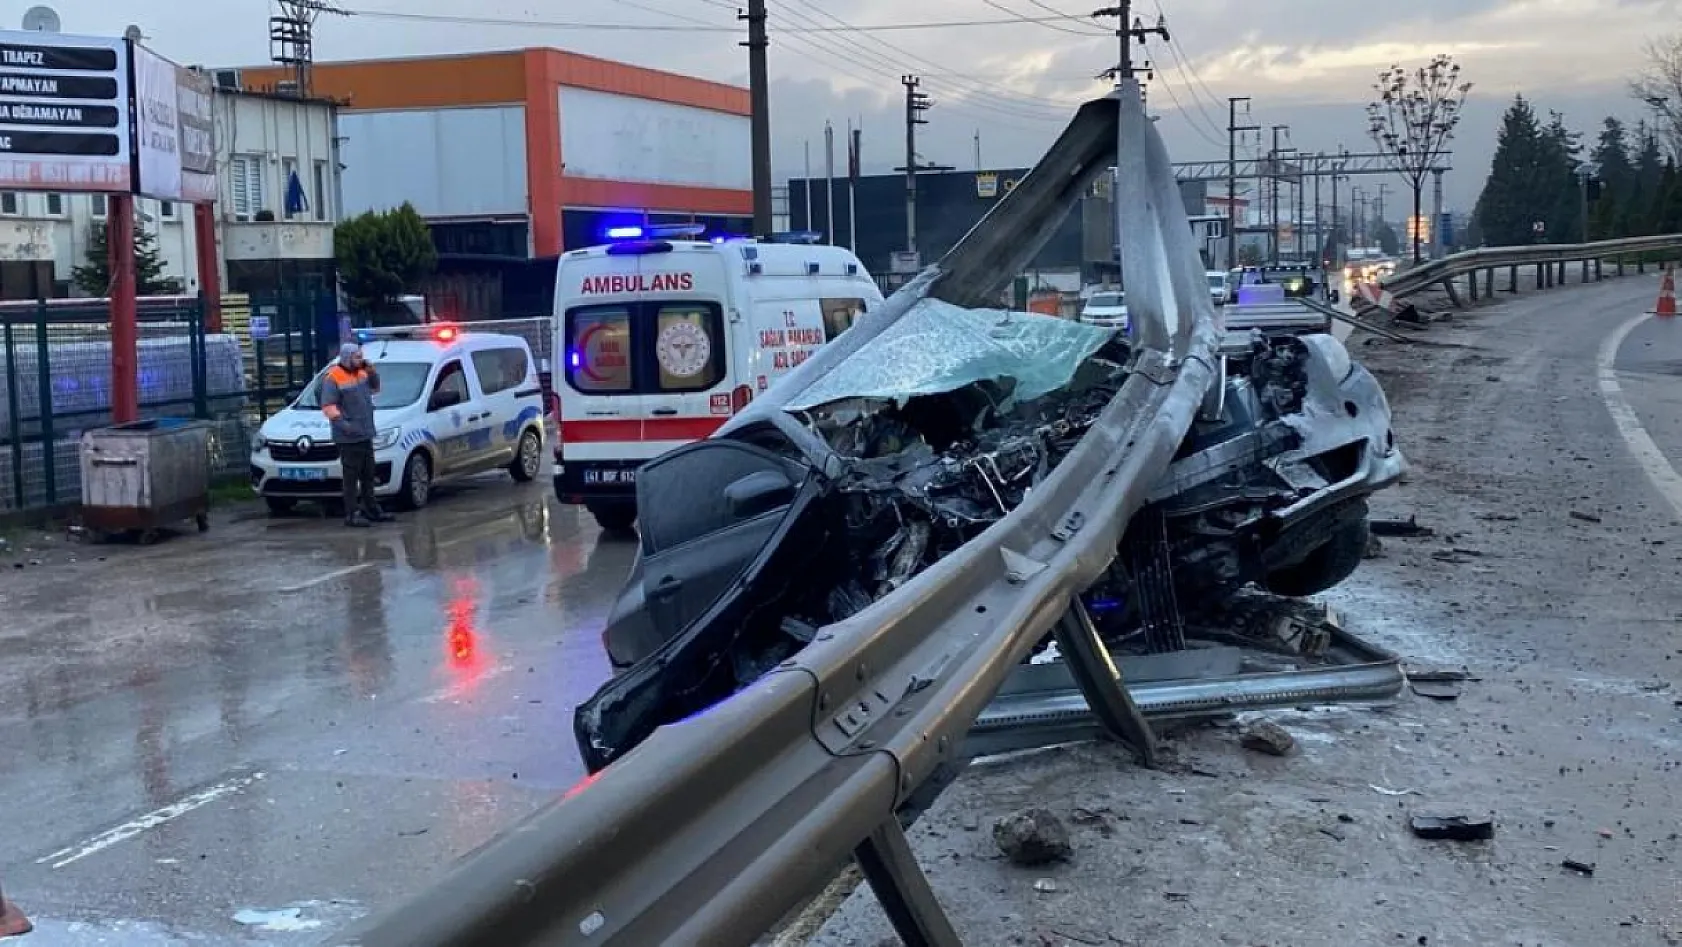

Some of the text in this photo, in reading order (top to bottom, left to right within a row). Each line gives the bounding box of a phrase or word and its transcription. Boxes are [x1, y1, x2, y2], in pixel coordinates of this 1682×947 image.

[3, 51, 43, 64] TRAPEZ
[581, 273, 693, 294] AMBULANS
[712, 395, 728, 406] 112
